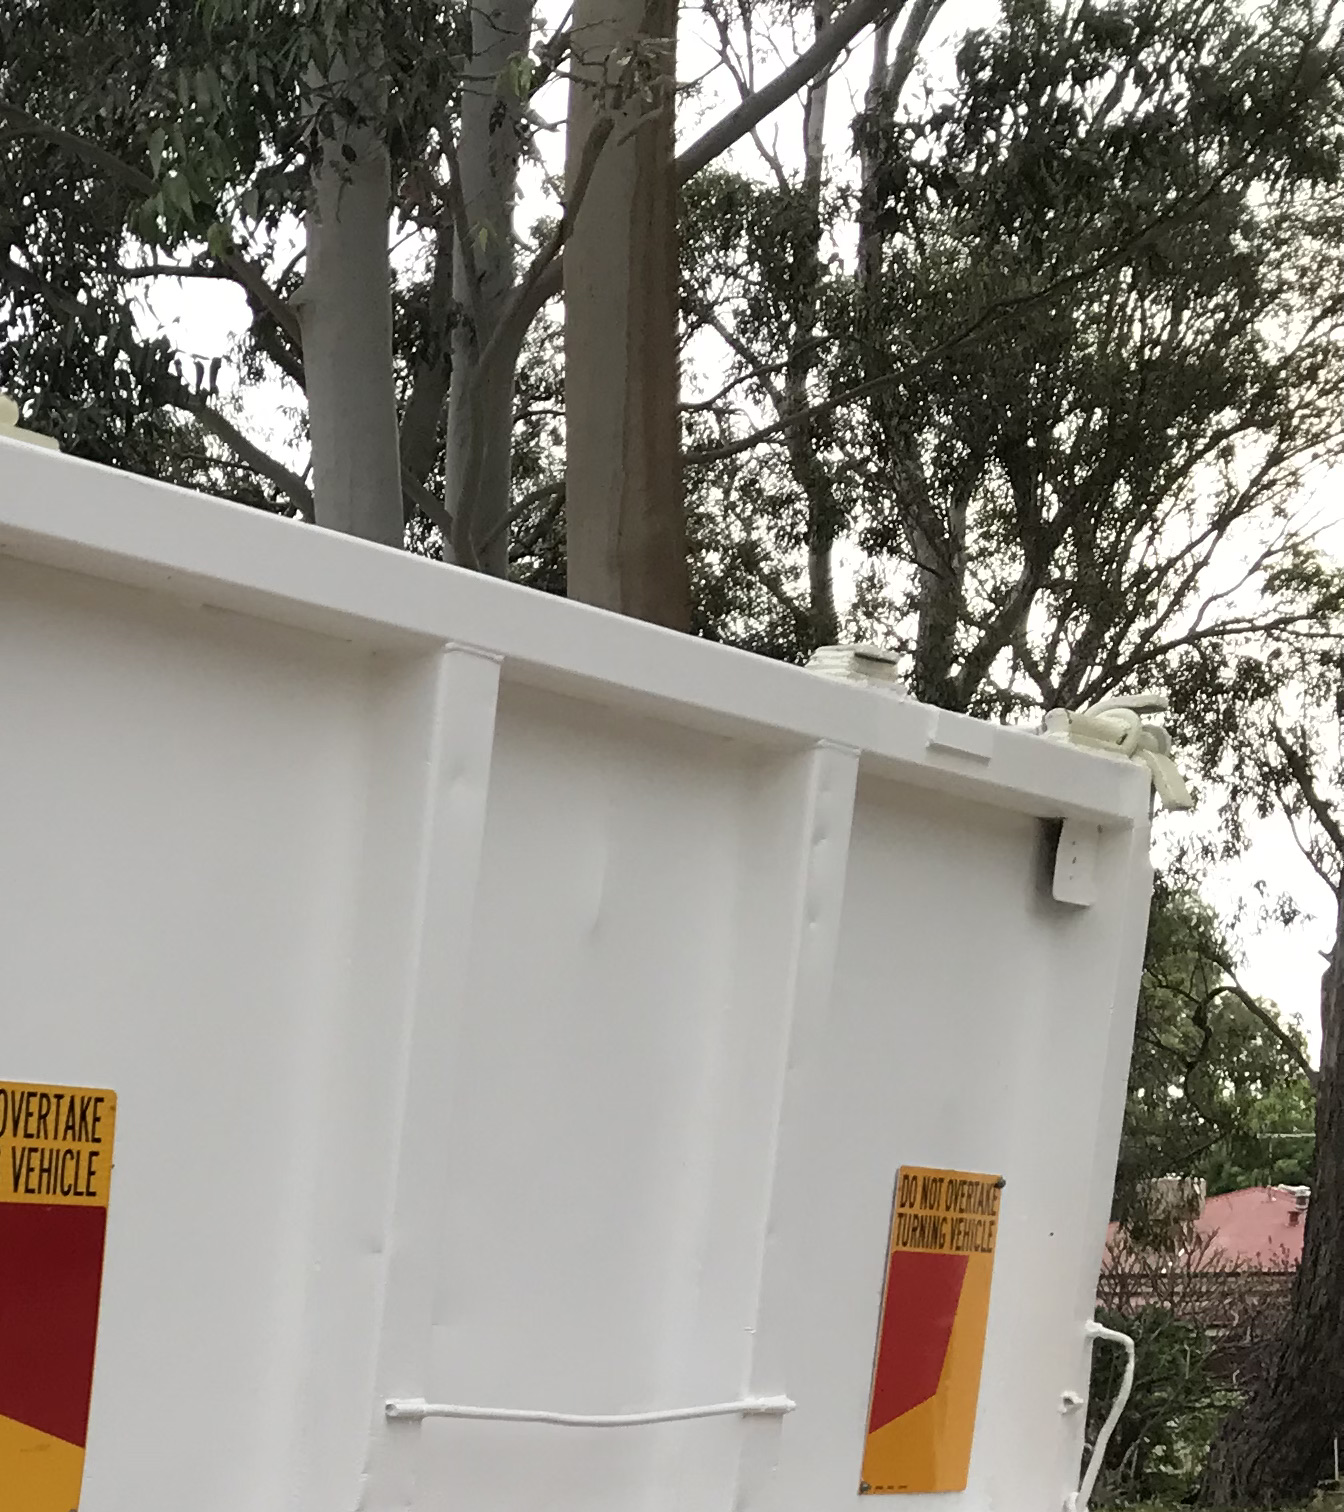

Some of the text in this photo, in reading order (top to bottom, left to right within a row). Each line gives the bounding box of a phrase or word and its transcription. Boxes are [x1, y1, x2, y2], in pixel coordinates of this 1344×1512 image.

[11, 1145, 100, 1197] VEHICLE
[899, 1174, 998, 1217] DO NOT OVERTAKE
[895, 1212, 997, 1253] TURNING VEHICLE
